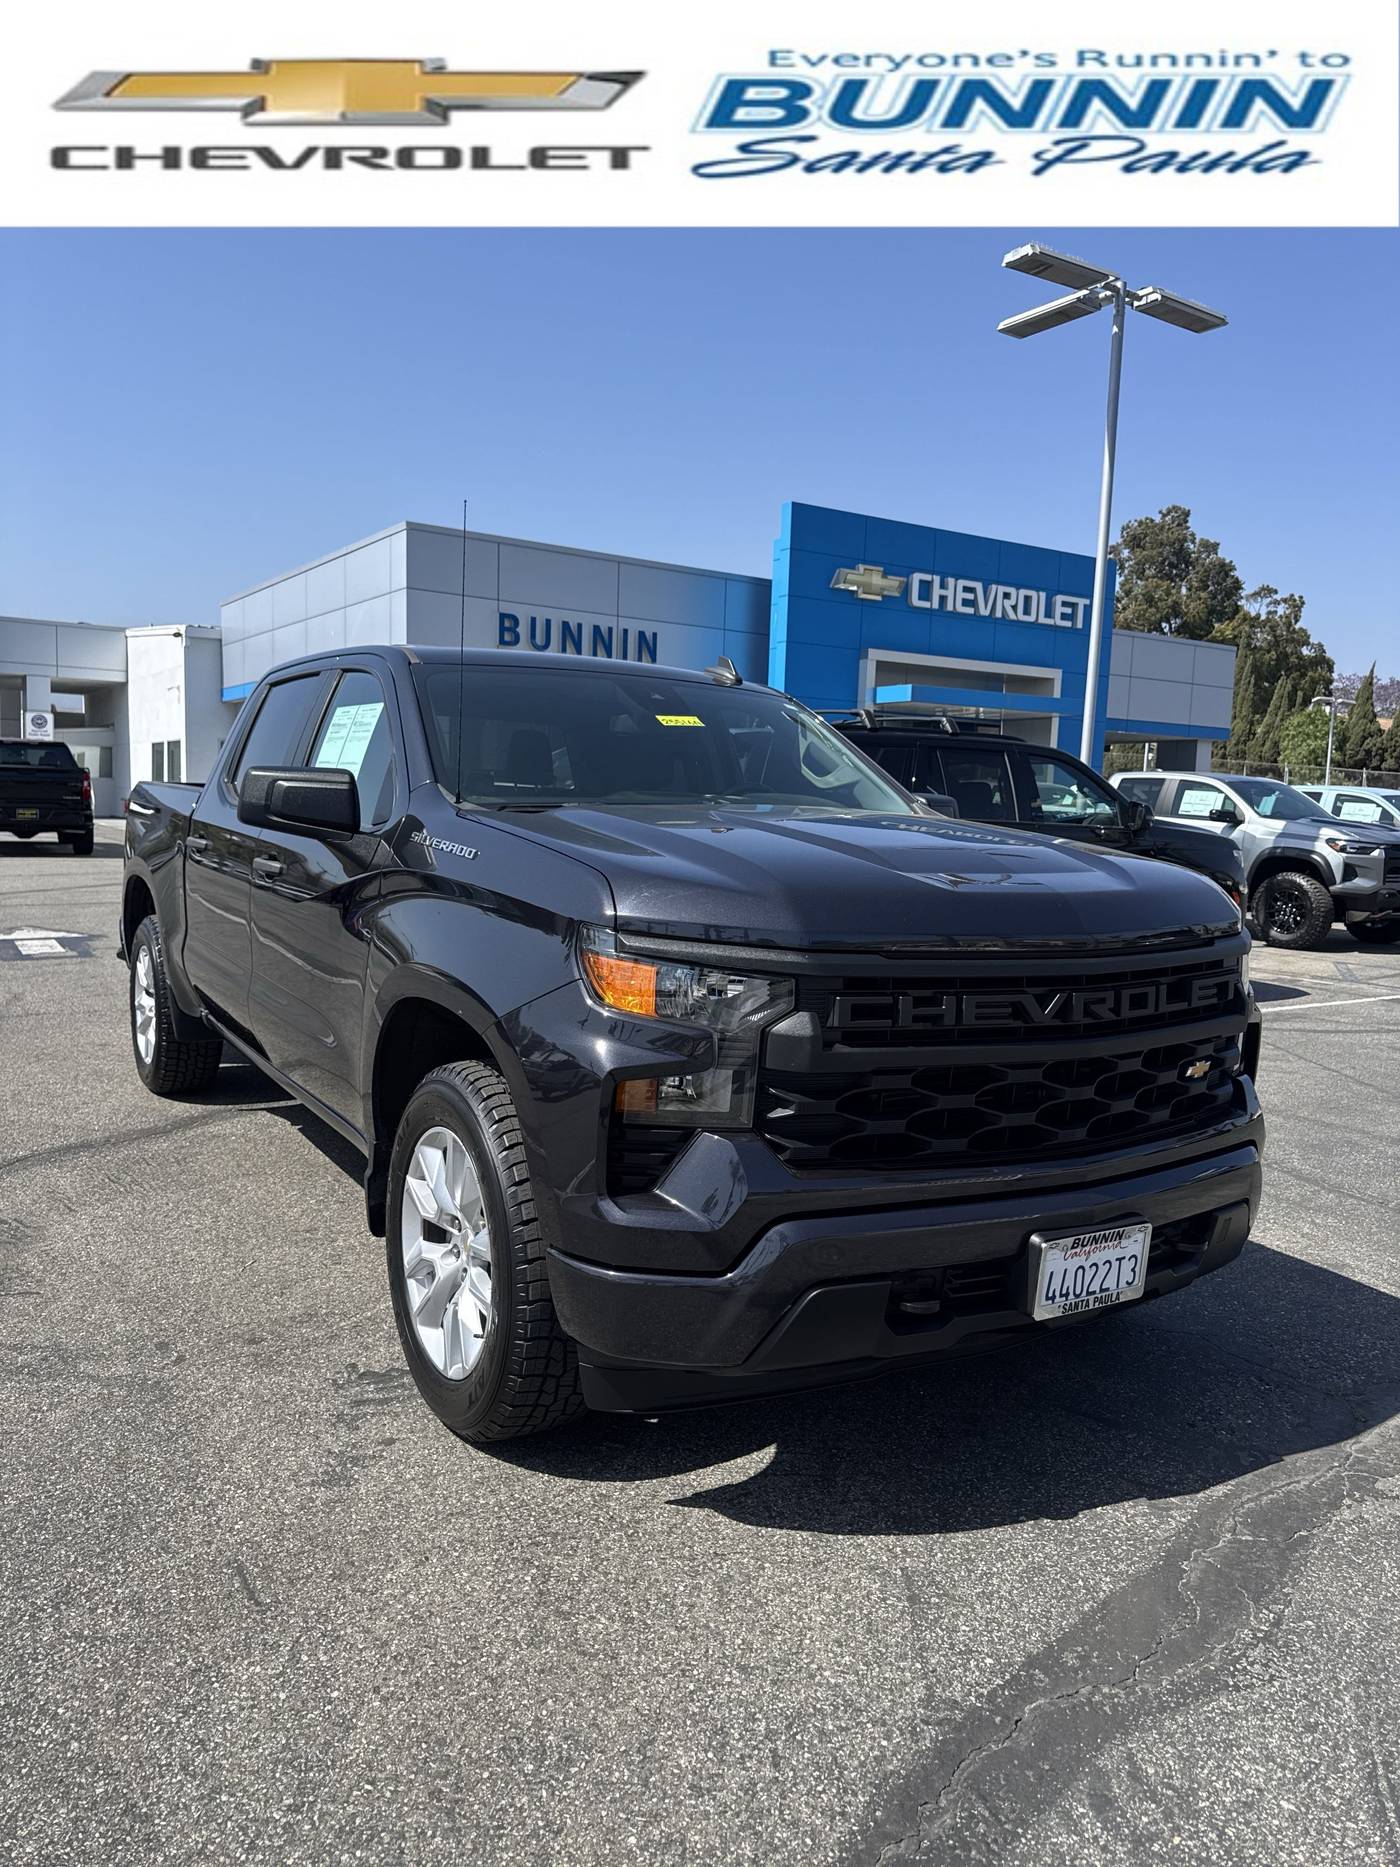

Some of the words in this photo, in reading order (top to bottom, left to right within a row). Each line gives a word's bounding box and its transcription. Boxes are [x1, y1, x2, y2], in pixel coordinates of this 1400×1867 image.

[908, 572, 1090, 629] CHEVROLET
[498, 612, 658, 664] BUNNIN
[409, 831, 475, 859] SILVERADO
[827, 978, 1236, 1028] CHEVROLET
[1063, 1240, 1129, 1262] California
[1070, 1229, 1126, 1250] BUNNIN
[1044, 1254, 1138, 1305] 44022T3
